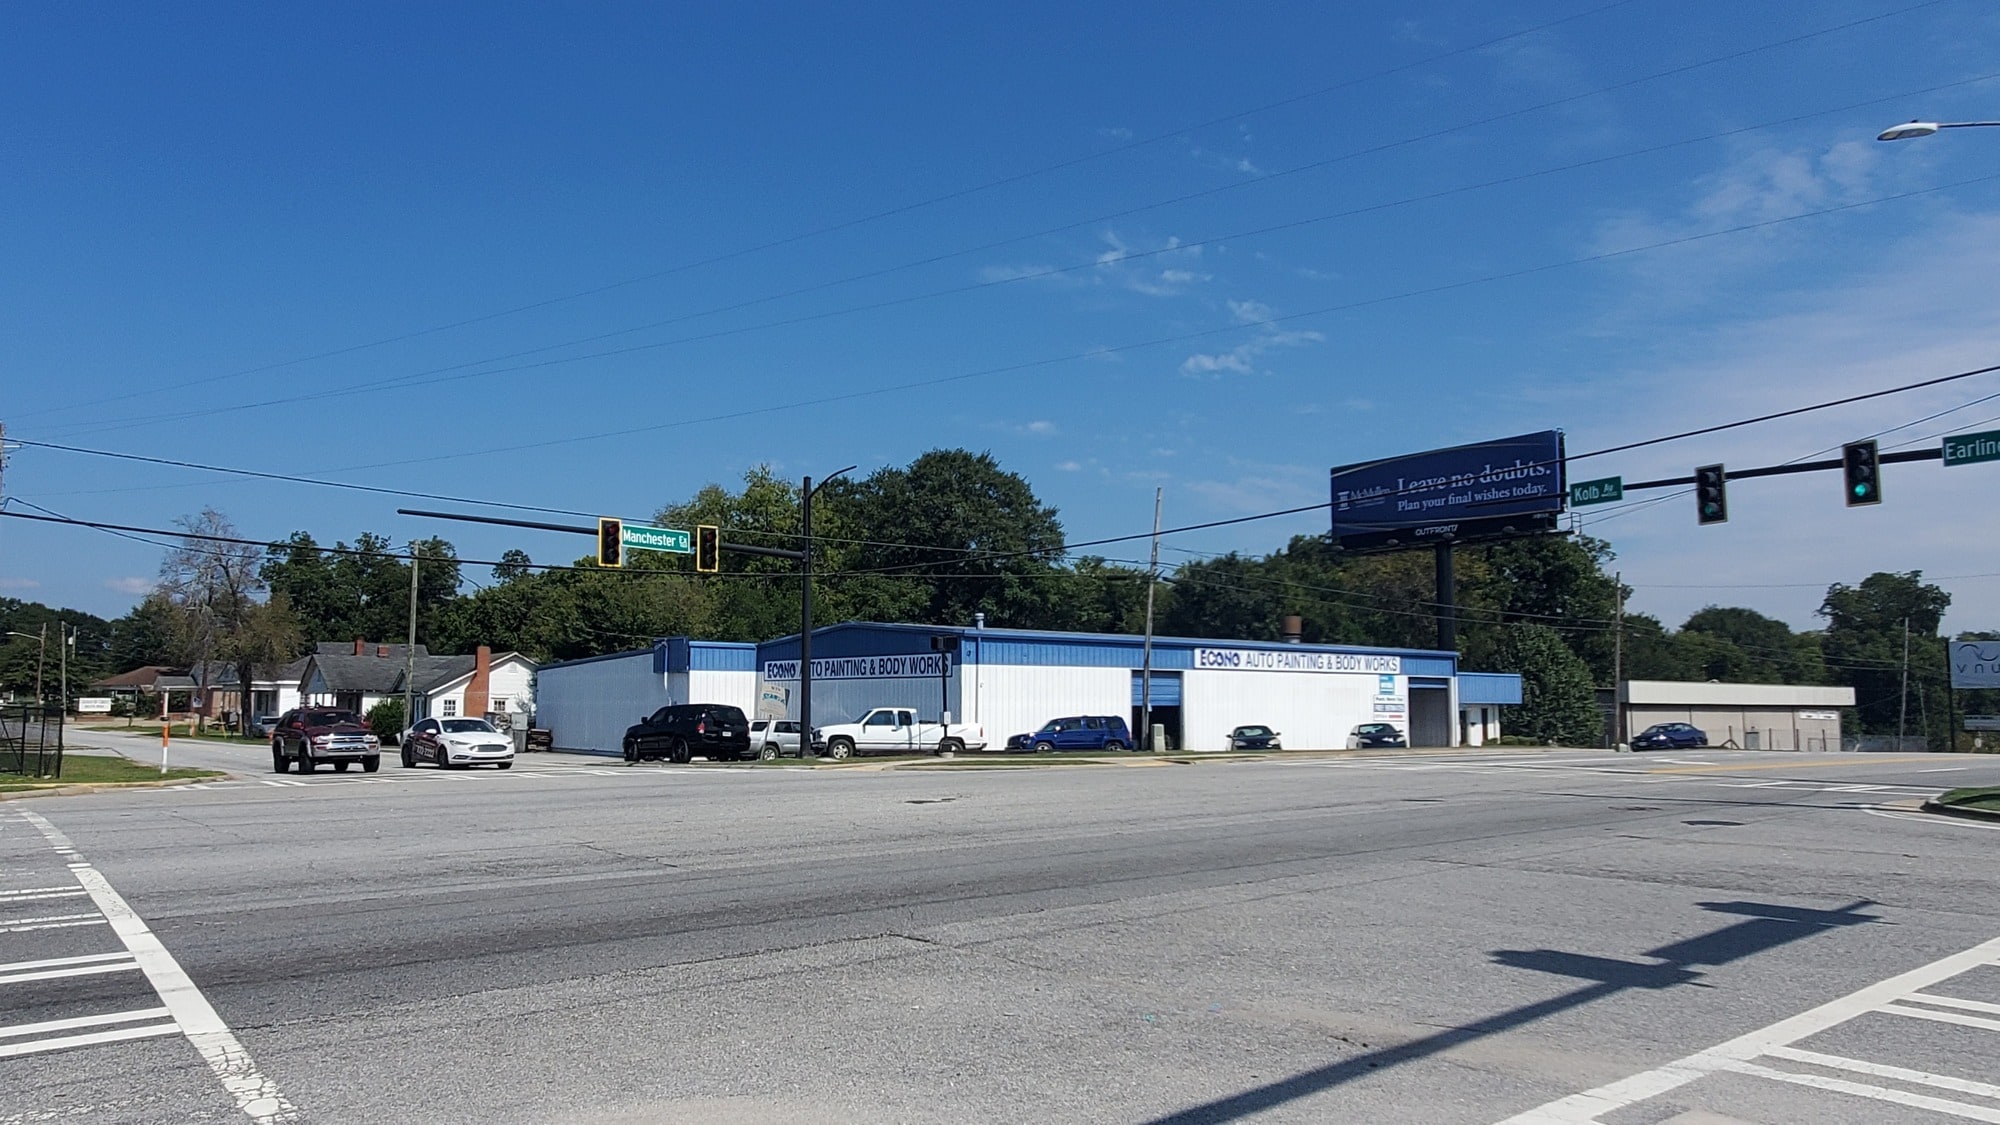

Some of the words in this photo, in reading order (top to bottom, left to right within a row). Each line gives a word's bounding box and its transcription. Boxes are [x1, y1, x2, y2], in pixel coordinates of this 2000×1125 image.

[1945, 439, 2000, 460] Earlin
[1397, 474, 1447, 496] Leave
[1450, 472, 1476, 488] no
[1479, 459, 1551, 484] doubts.
[1397, 497, 1420, 511] Plan
[1422, 496, 1446, 511] your
[1448, 493, 1473, 505] final
[1474, 486, 1511, 503] wishes
[1512, 482, 1548, 498] today.
[1574, 485, 1600, 502] Kolb
[623, 529, 677, 547] Manchester
[767, 662, 796, 679] ECONO
[824, 658, 867, 677] PAINTING
[869, 661, 876, 676] &
[878, 656, 907, 675] BODY
[908, 655, 949, 675] WORKS
[1200, 649, 1241, 667] ECONO
[1245, 652, 1274, 668] AUTO
[1277, 652, 1324, 670] PAINTING
[1326, 656, 1333, 670] &
[1335, 655, 1363, 671] BODY
[1364, 656, 1398, 672] WORKS
